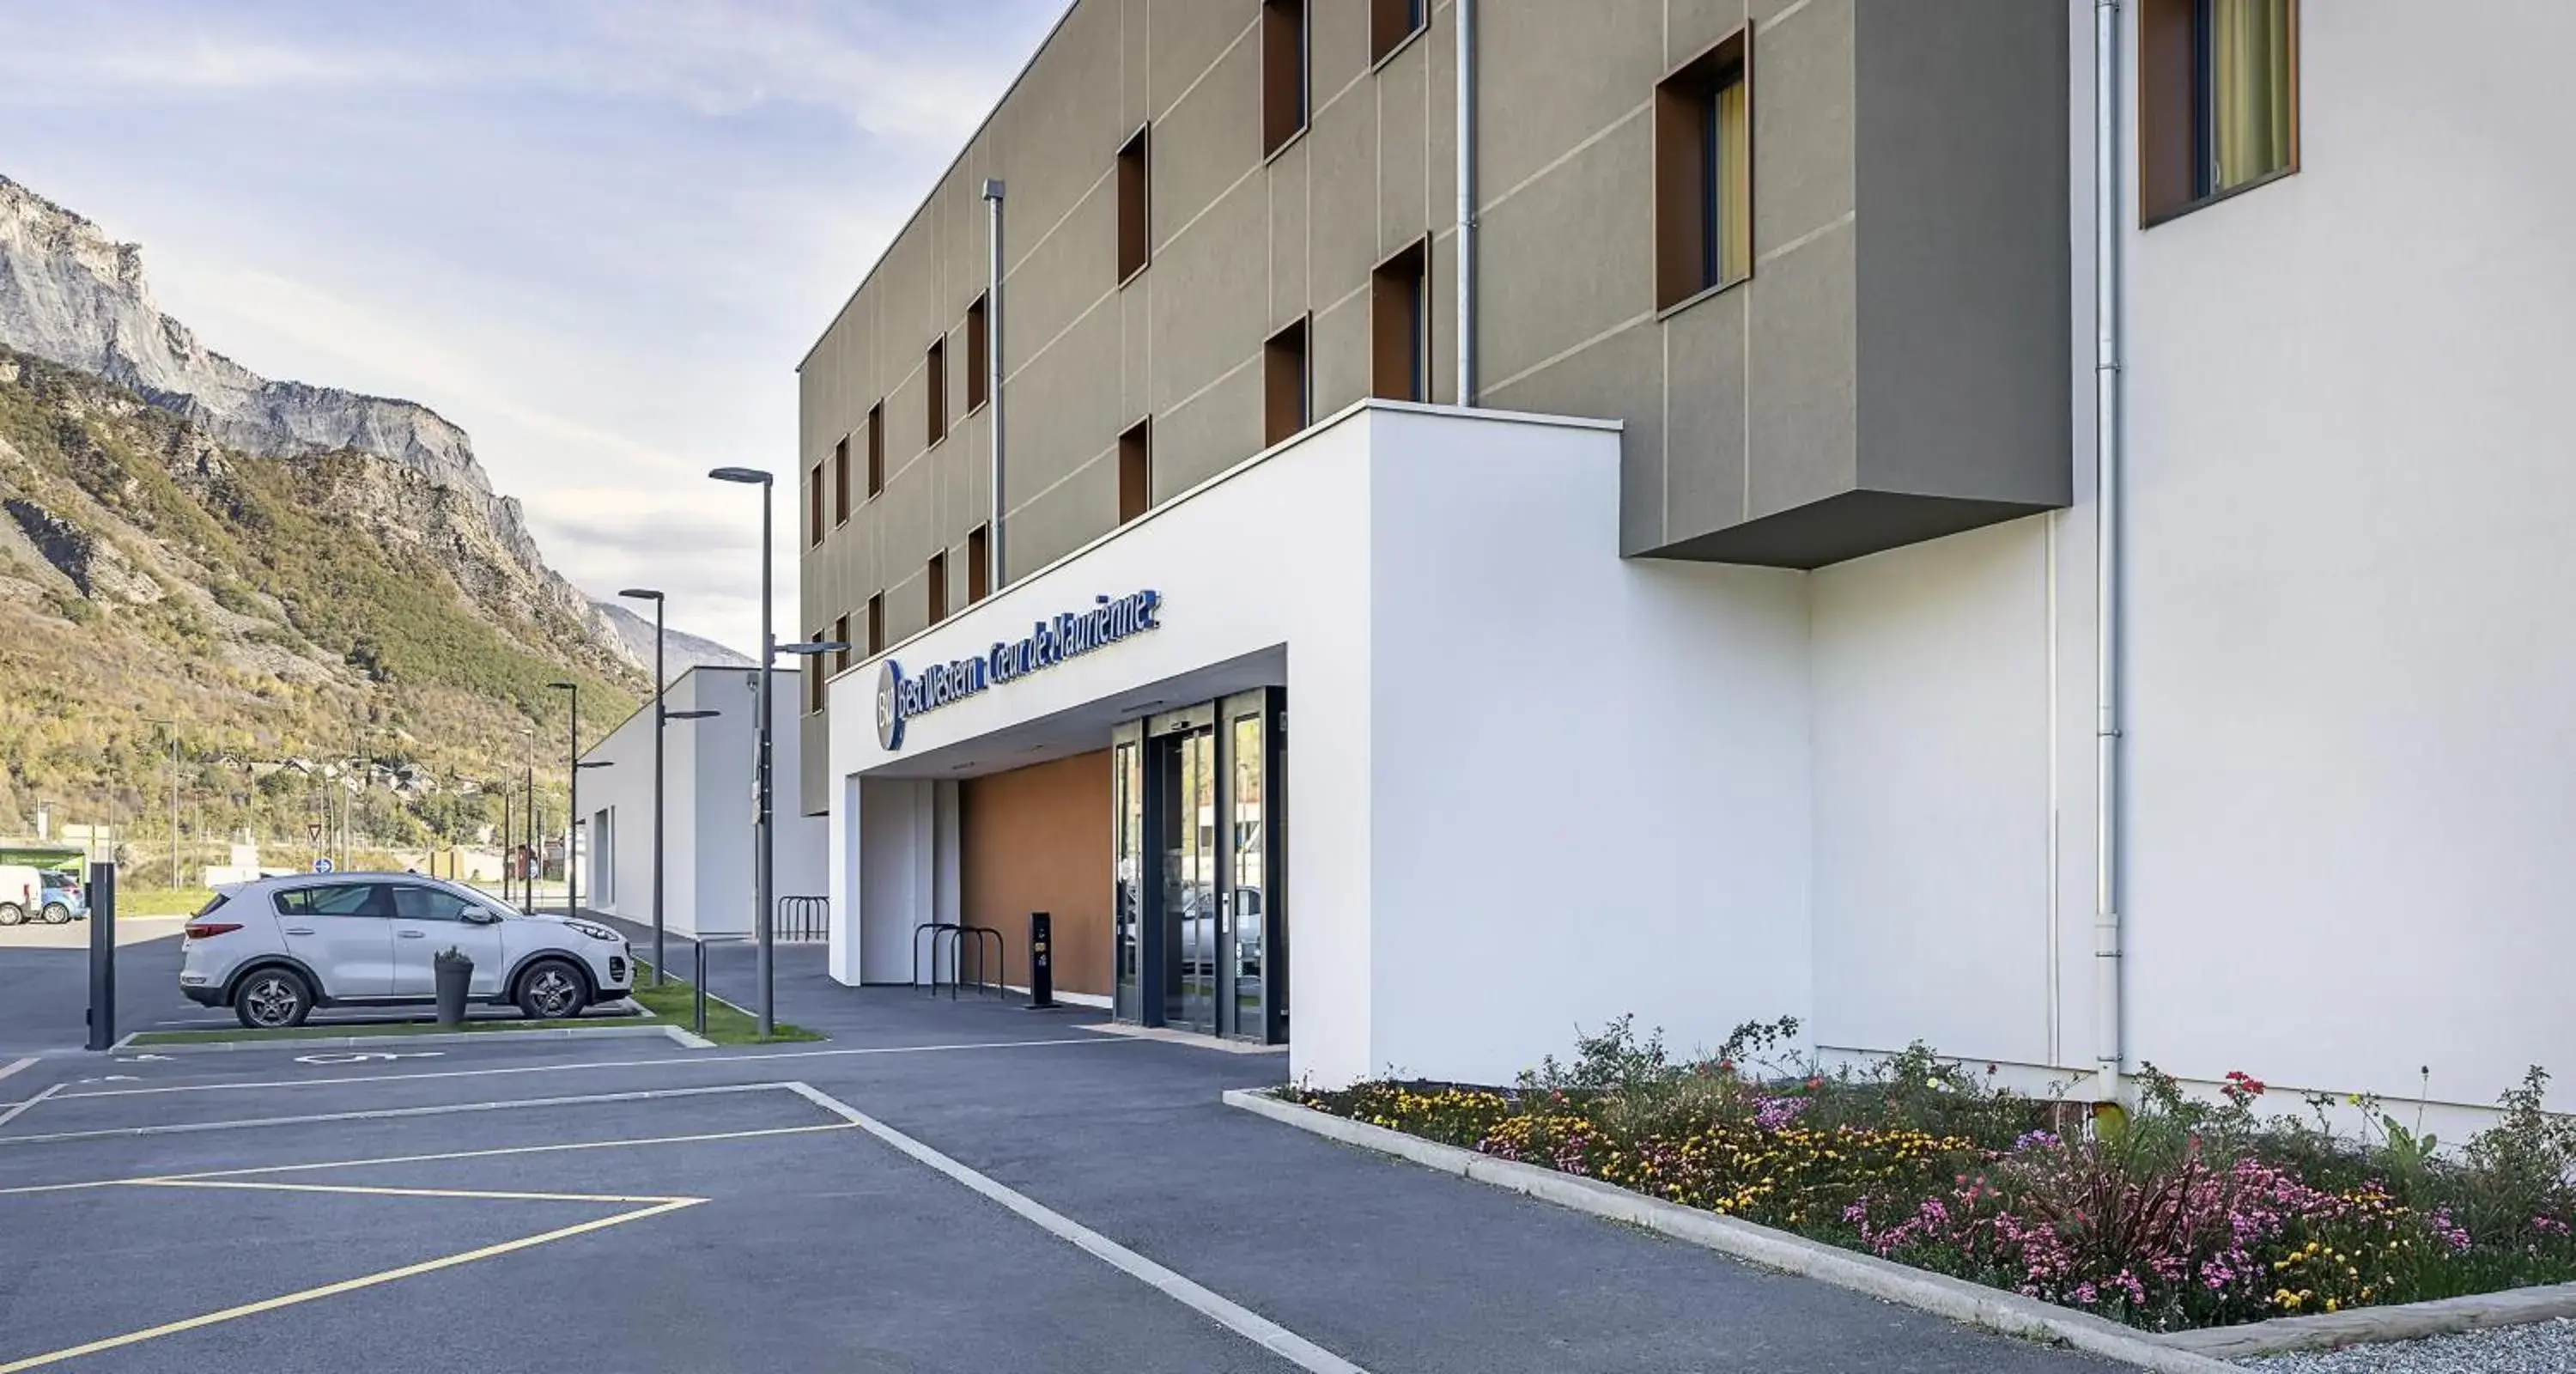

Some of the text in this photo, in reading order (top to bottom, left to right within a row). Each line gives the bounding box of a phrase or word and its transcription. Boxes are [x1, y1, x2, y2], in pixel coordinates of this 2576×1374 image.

[898, 590, 1151, 719] Best Western Cœur de Maurienne
